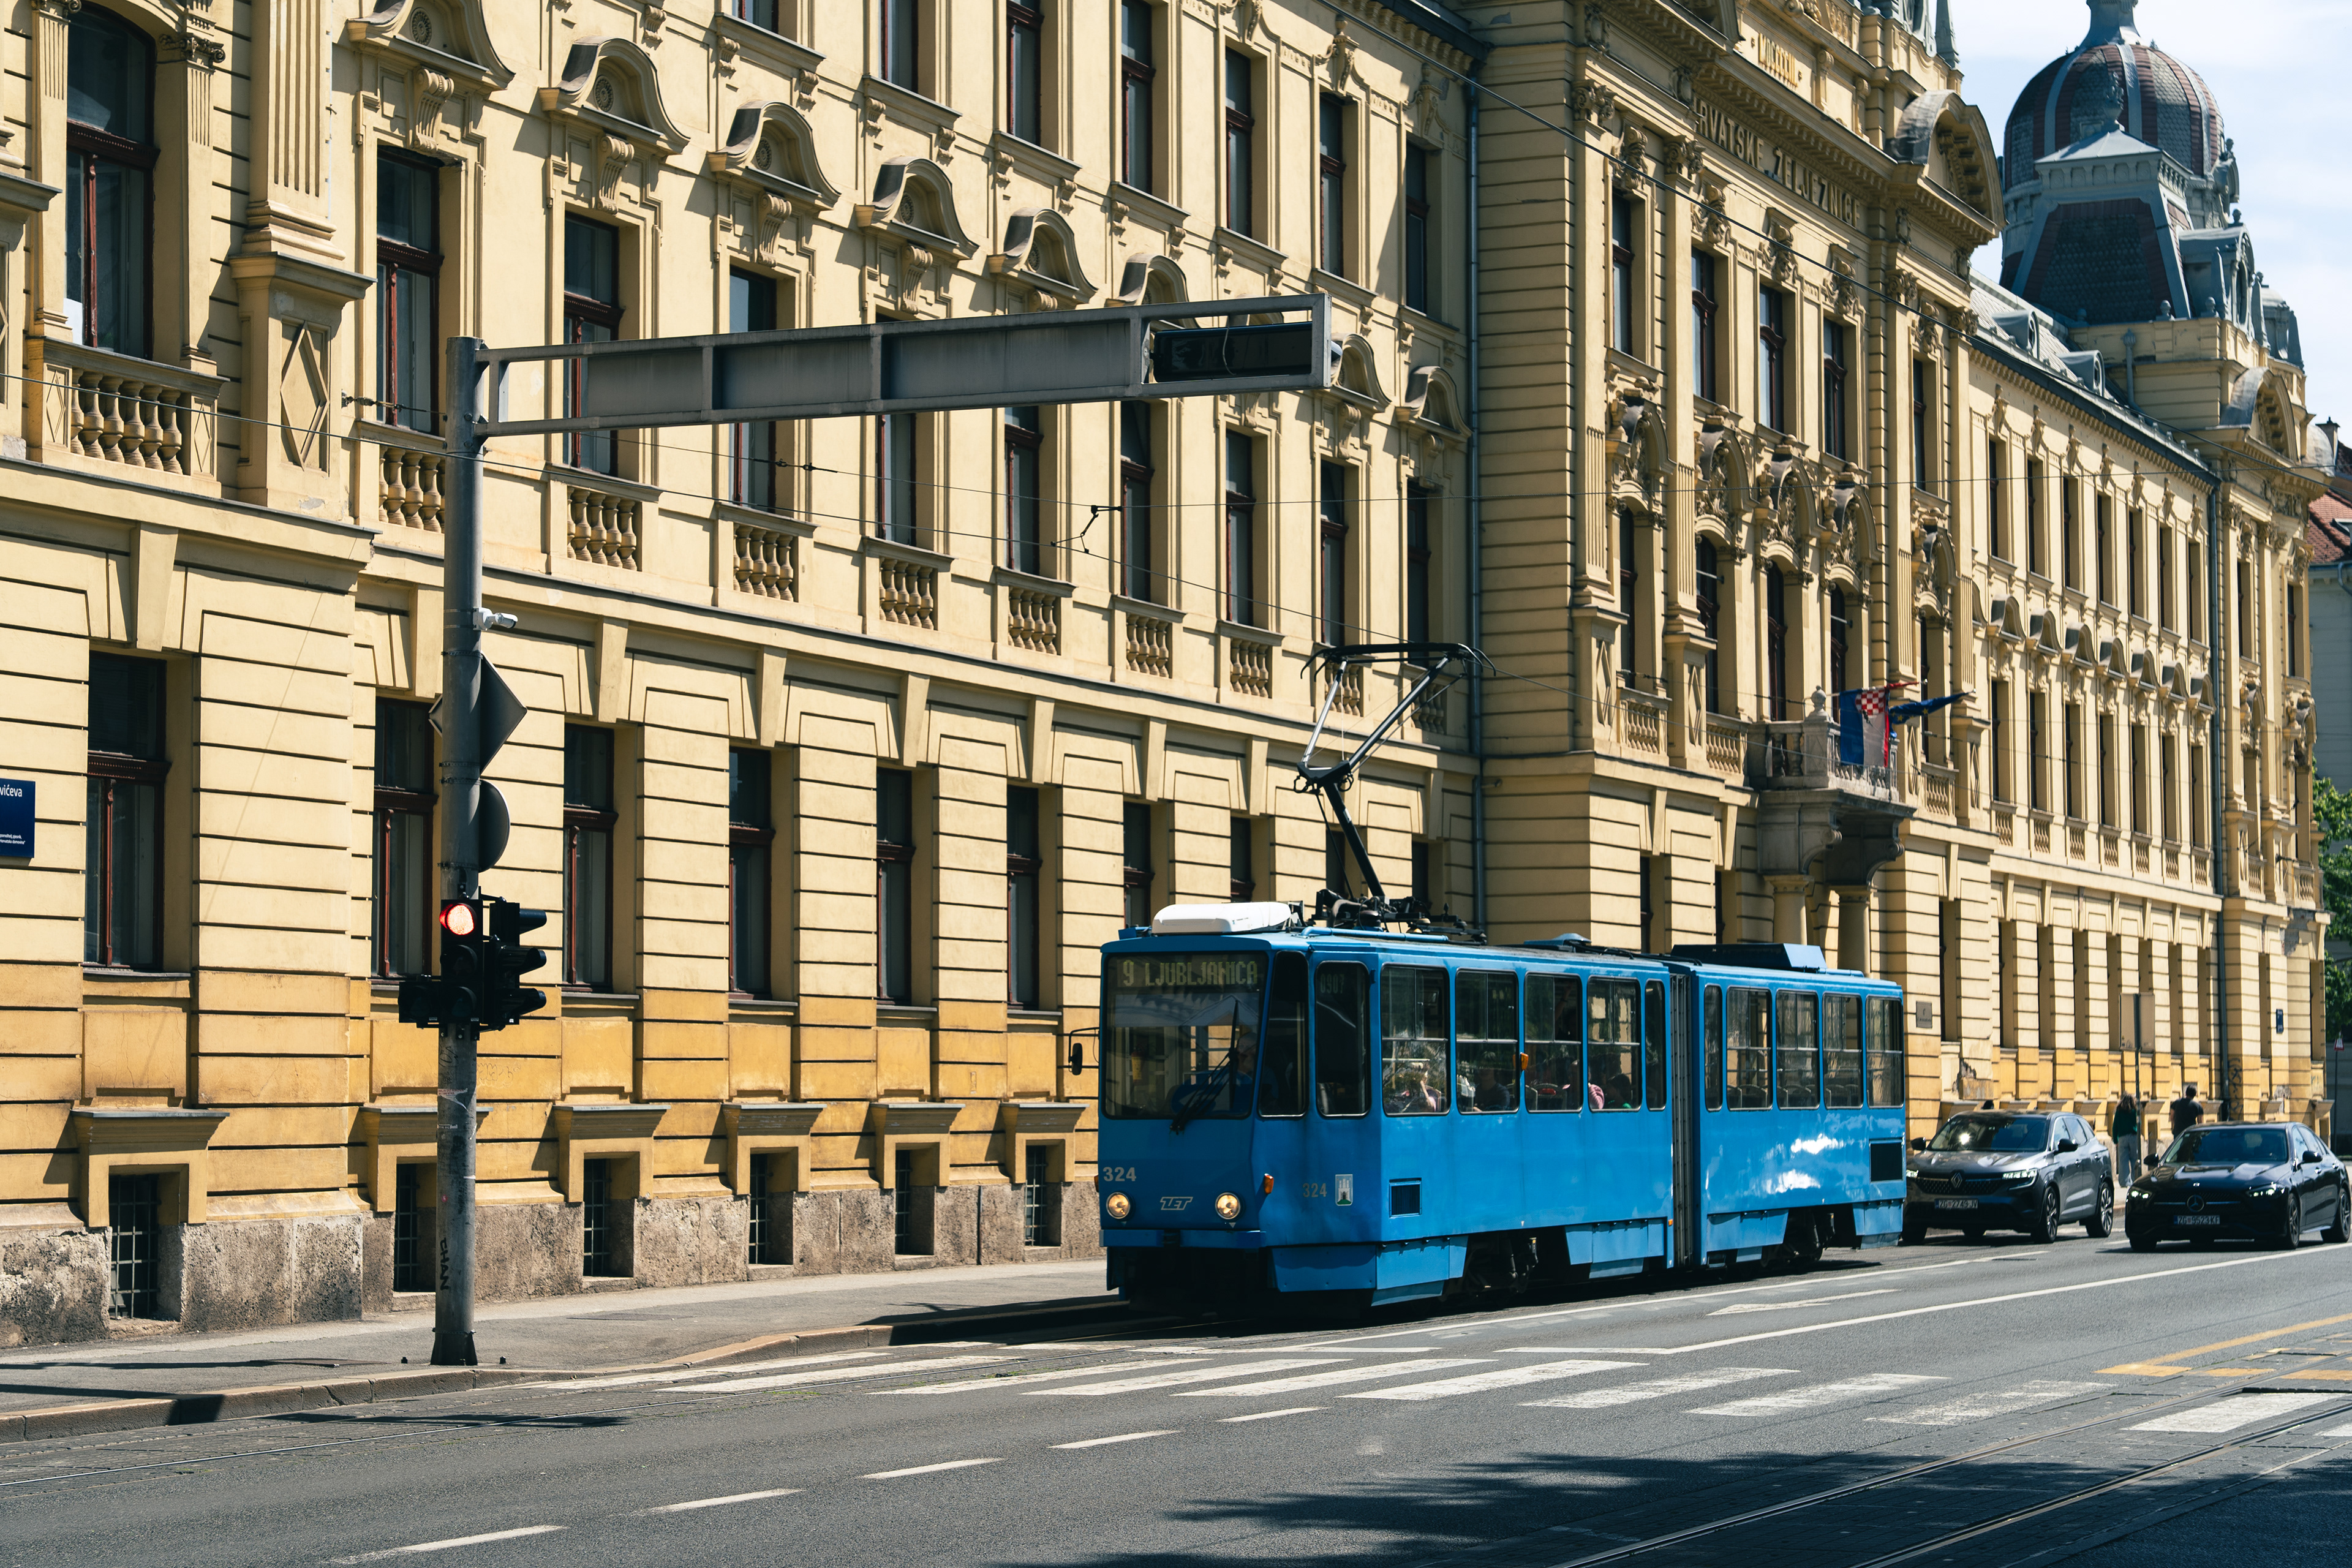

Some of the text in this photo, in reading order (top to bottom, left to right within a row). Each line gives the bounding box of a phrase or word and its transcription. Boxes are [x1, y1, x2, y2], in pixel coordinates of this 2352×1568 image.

[1123, 960, 1258, 987] 9 LJUBLJANICA
[1320, 973, 1345, 994] 0907
[1102, 1167, 1137, 1182] 324
[1302, 1183, 1327, 1198] 324
[1159, 1196, 1194, 1211] ZET
